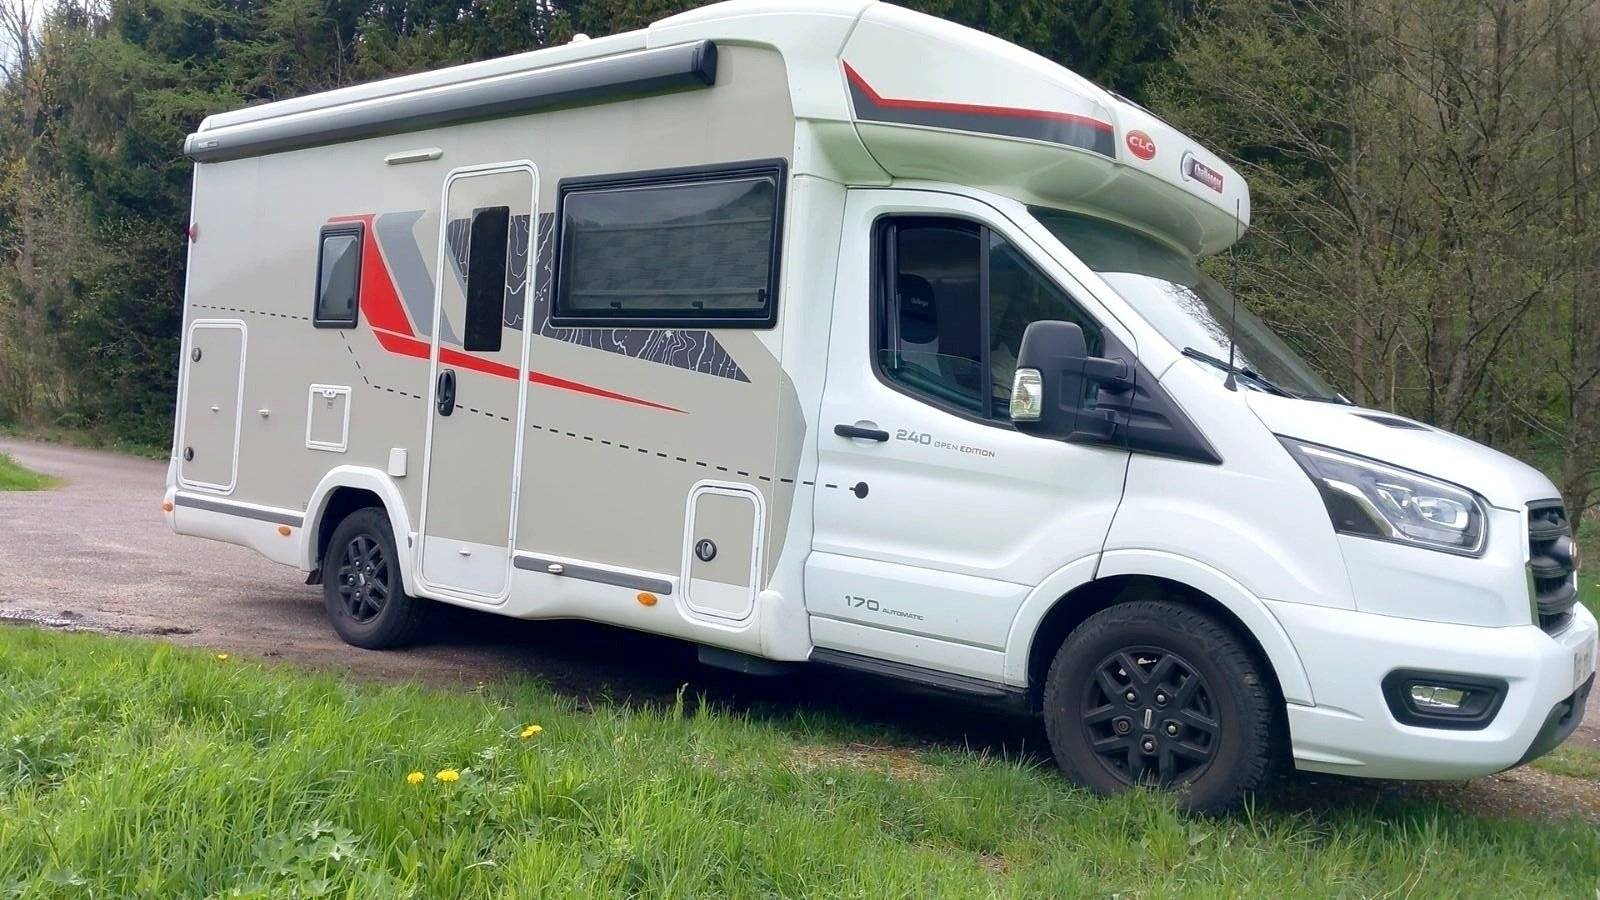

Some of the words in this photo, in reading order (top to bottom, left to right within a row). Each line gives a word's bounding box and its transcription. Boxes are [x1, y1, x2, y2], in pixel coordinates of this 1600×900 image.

[1129, 136, 1154, 152] CLC
[896, 429, 932, 445] 240
[934, 441, 958, 450] OPEN
[960, 446, 995, 457] EDITION
[845, 595, 878, 611] 170
[882, 608, 924, 620] AUTOMATIC
